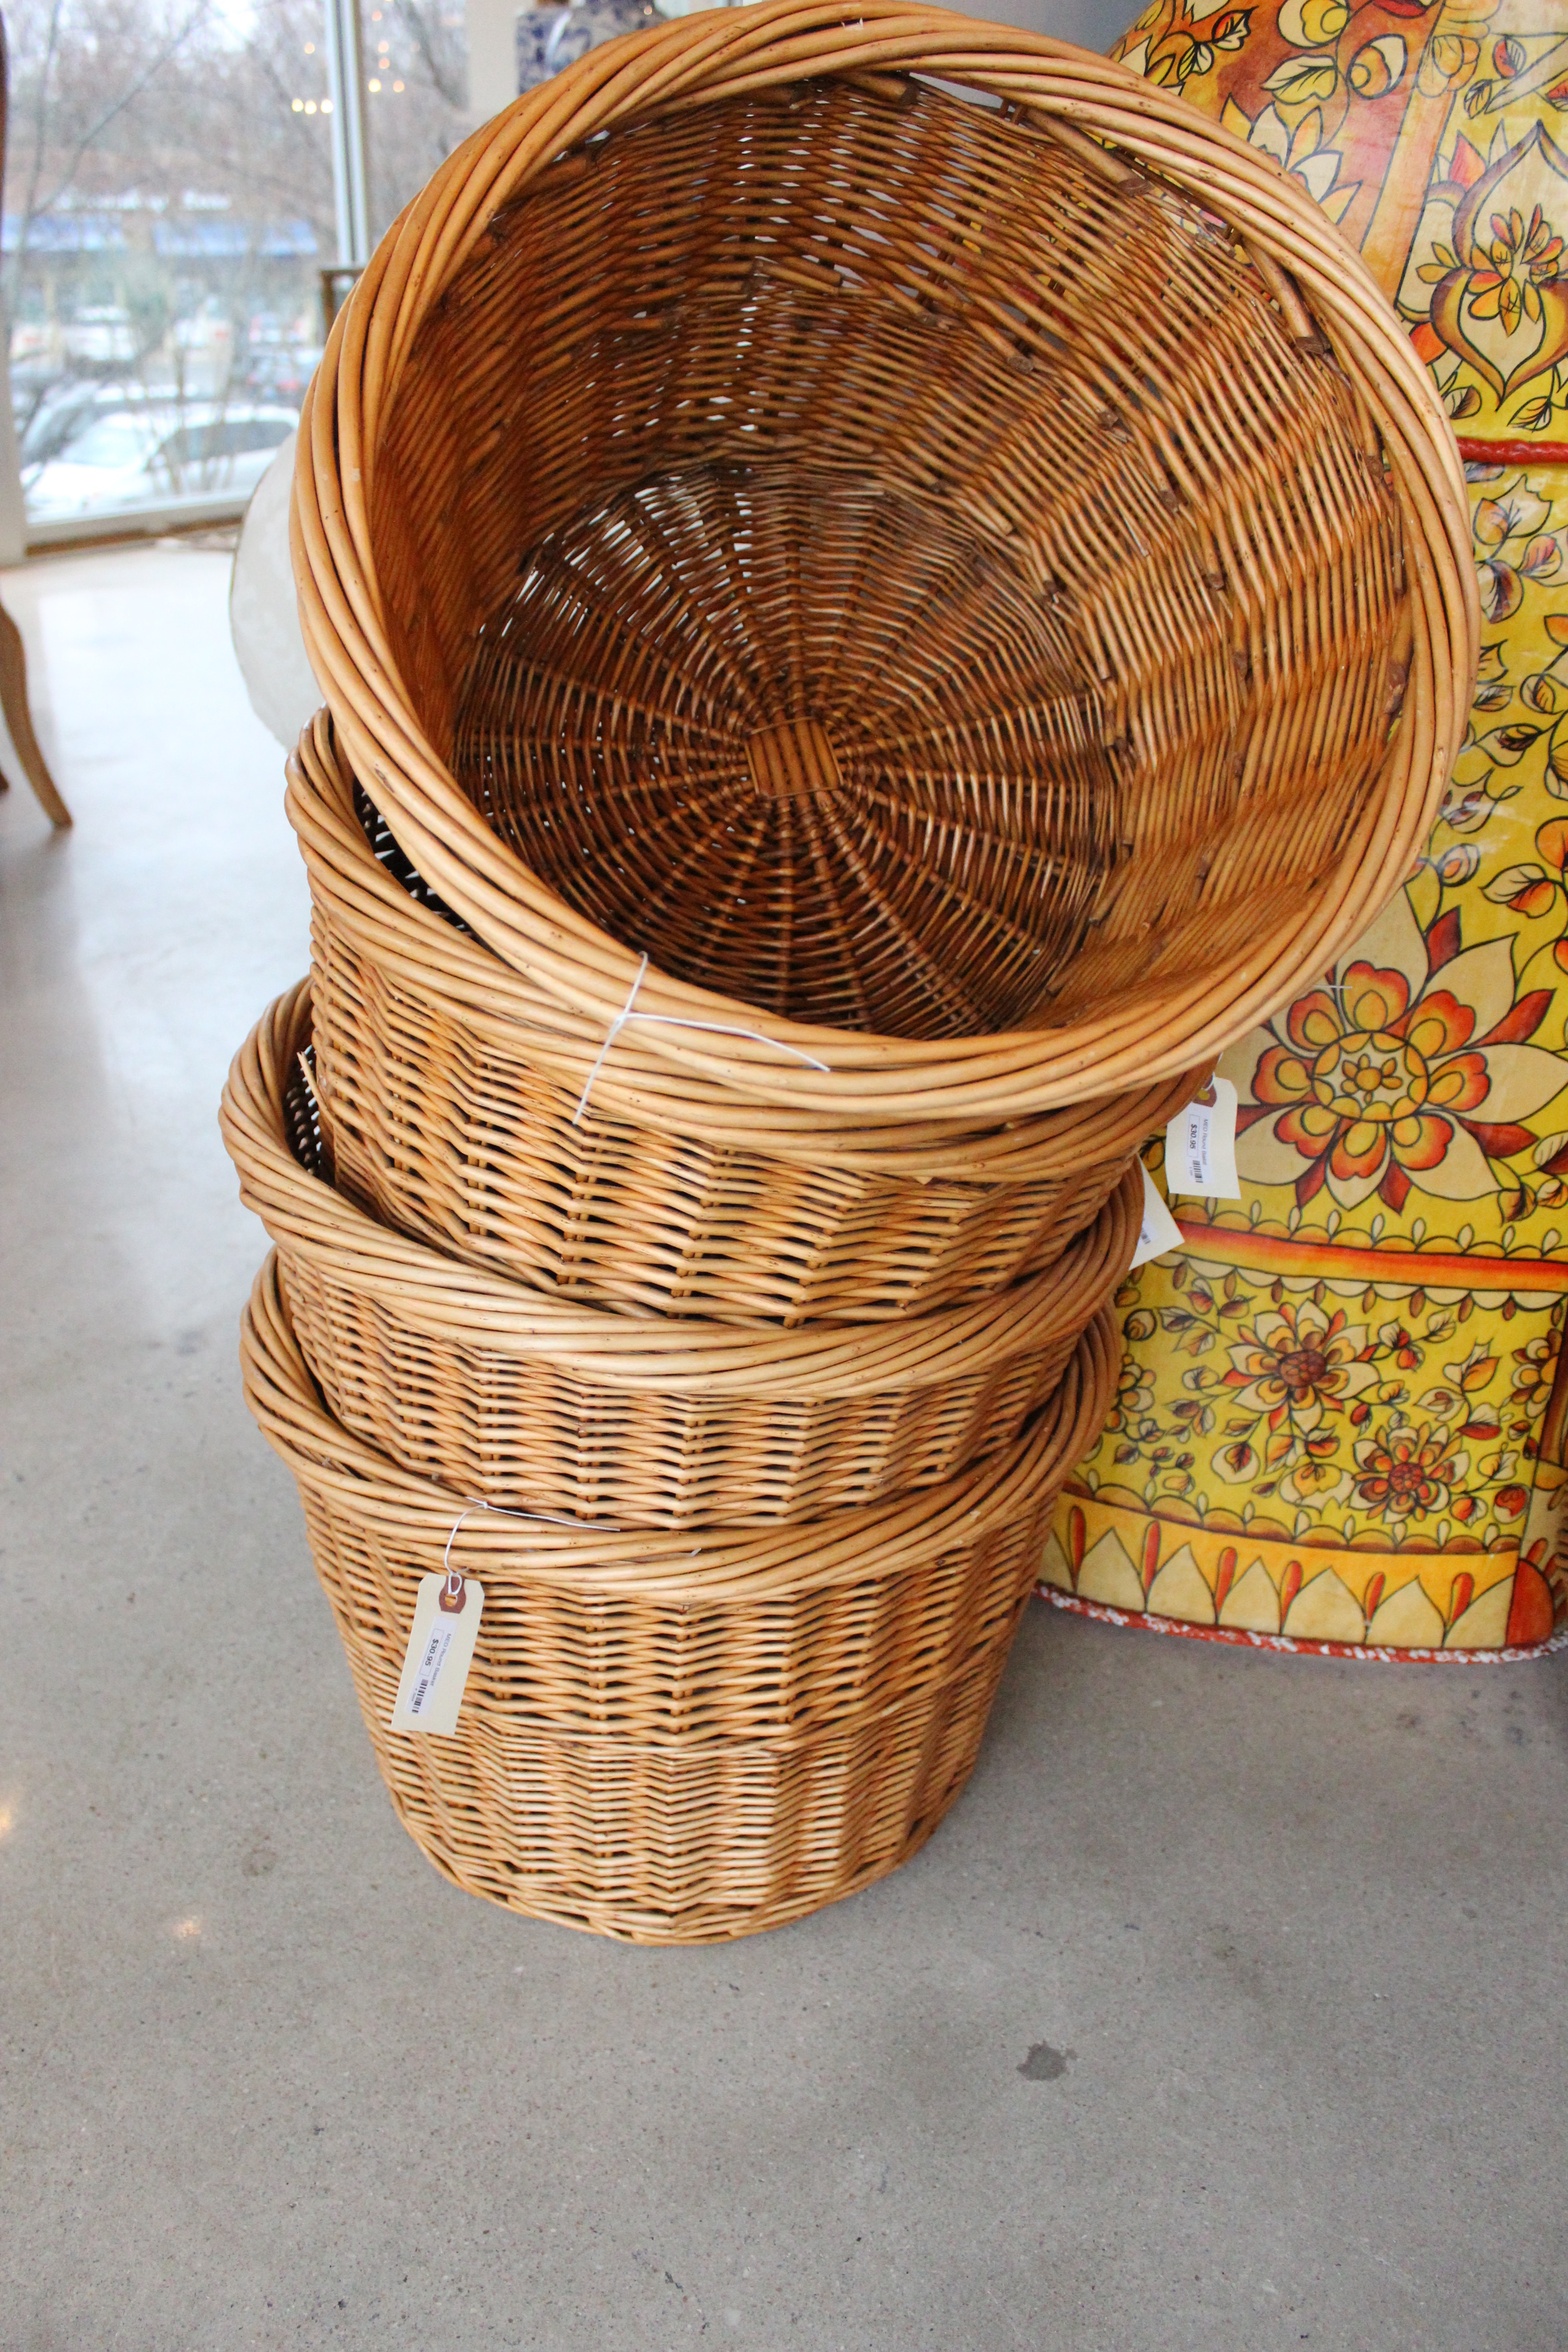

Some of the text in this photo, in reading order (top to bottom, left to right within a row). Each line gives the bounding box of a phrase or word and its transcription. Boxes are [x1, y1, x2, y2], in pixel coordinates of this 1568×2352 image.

[425, 1638, 439, 1666] $30.95
[437, 1648, 446, 1666] Round
[430, 1667, 440, 1686] Basket
